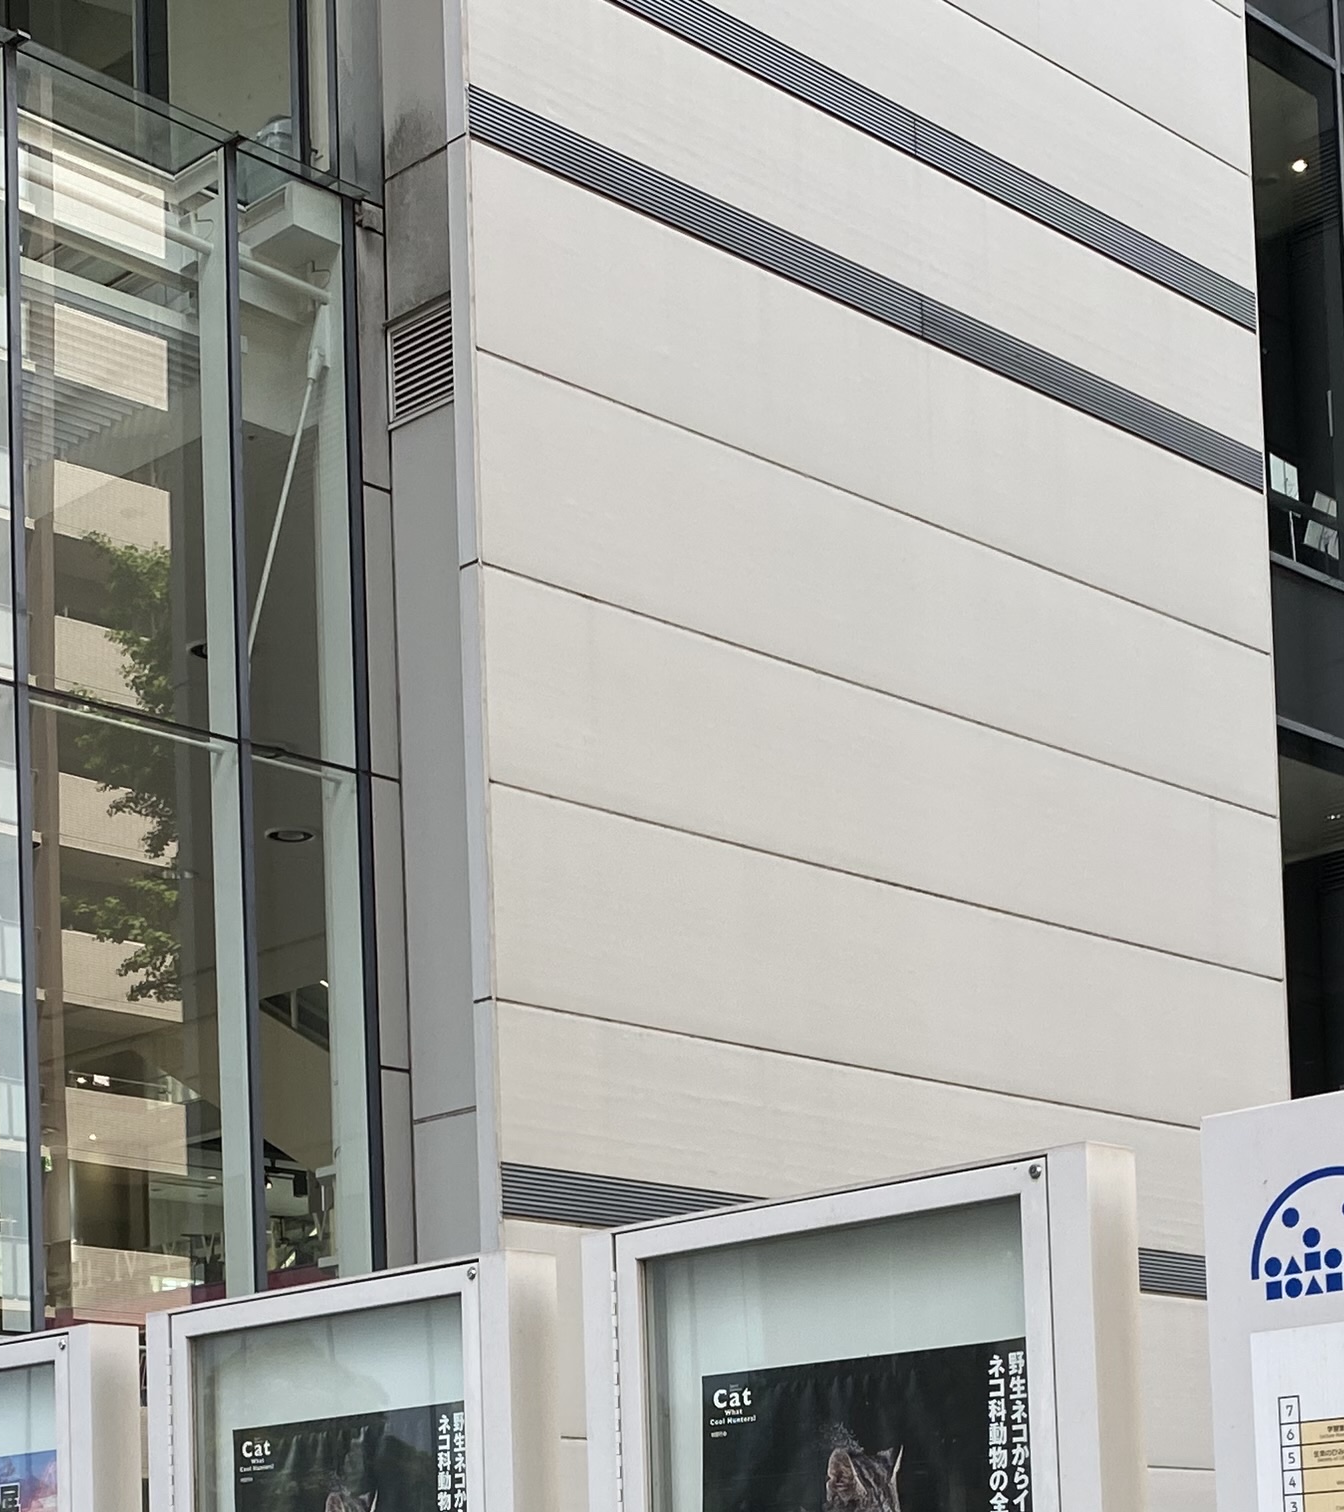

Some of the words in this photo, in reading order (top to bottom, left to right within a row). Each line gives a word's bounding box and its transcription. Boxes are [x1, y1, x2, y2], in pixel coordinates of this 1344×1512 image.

[713, 1387, 752, 1409] Cat
[1286, 1405, 1294, 1417] 7
[1287, 1429, 1295, 1441] 6
[242, 1440, 271, 1458] Cat
[1288, 1452, 1296, 1464] 5
[1289, 1477, 1296, 1488] 4
